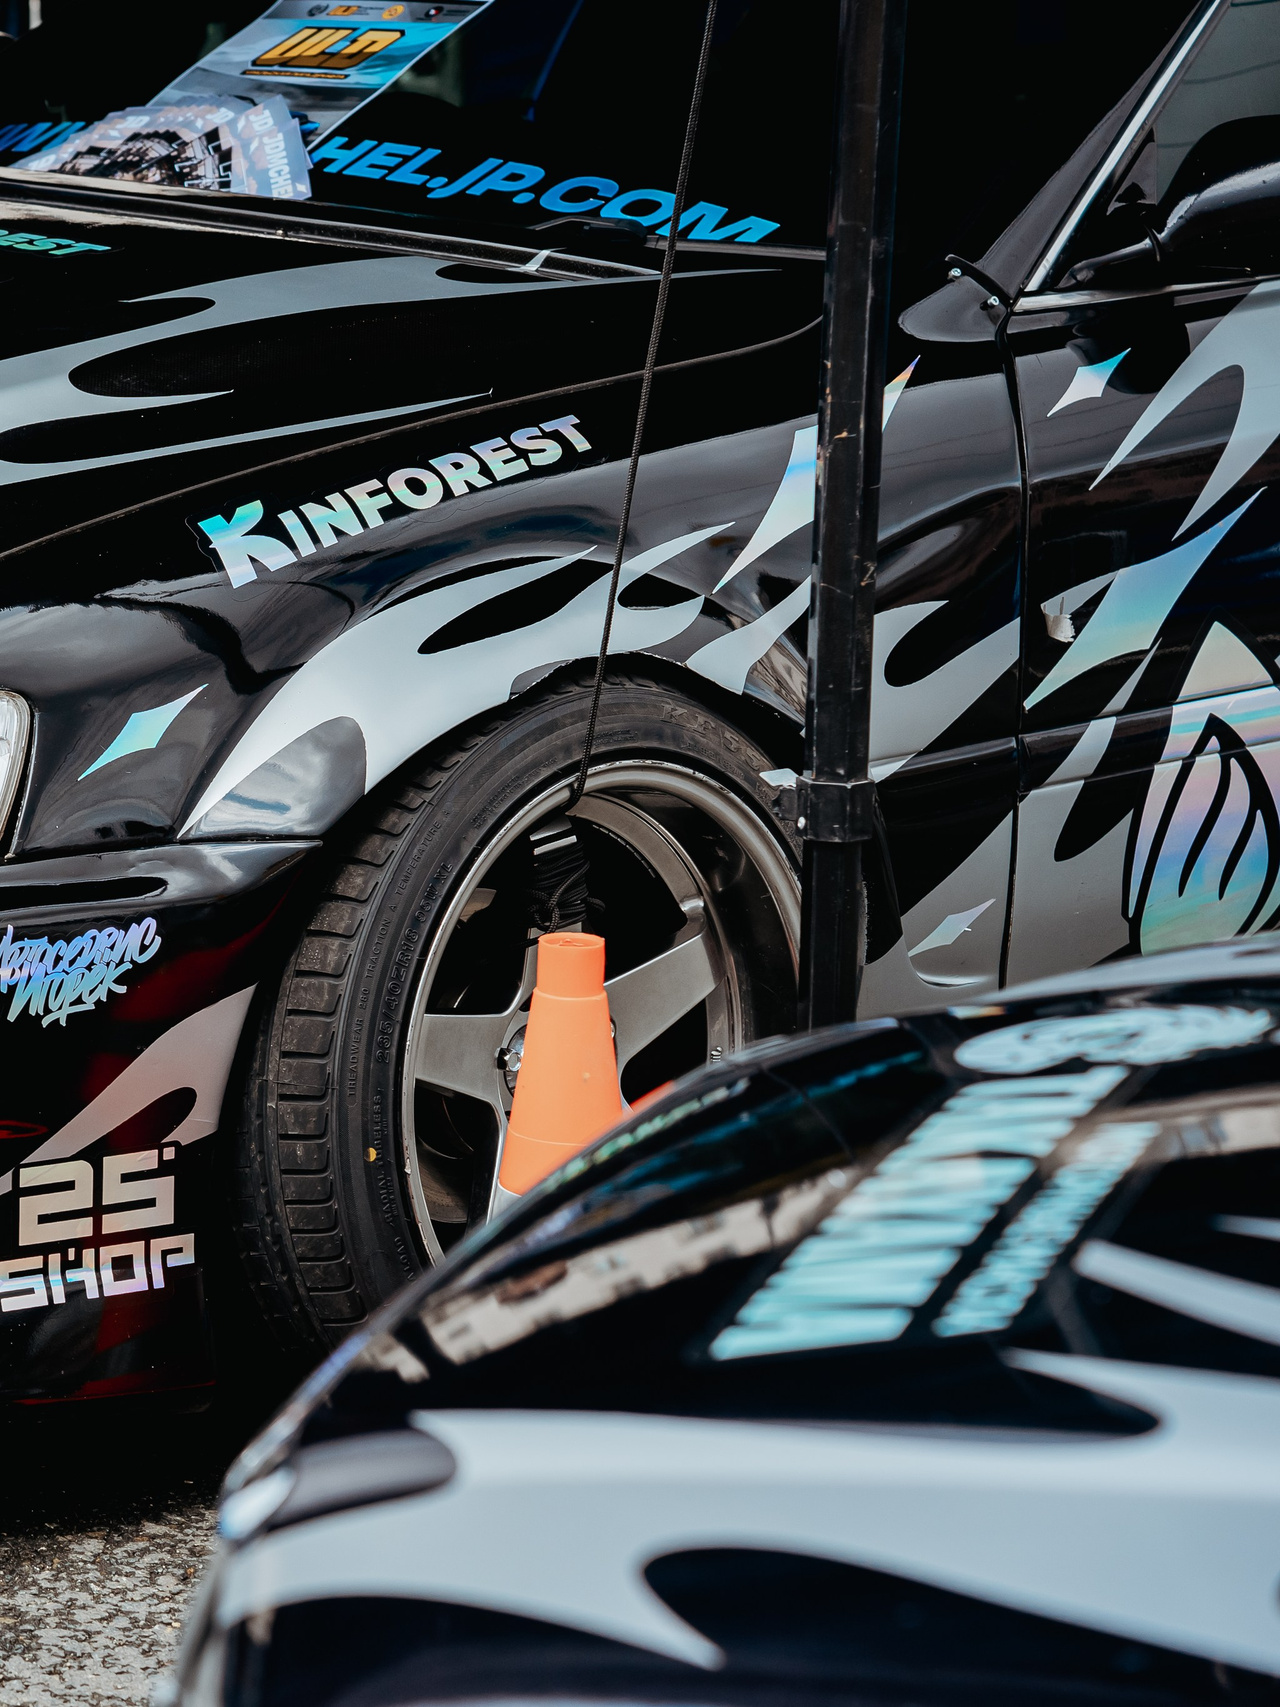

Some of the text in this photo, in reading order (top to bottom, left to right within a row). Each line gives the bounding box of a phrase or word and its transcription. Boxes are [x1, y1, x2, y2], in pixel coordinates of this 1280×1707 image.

[198, 414, 593, 589] KINFOREST
[347, 1018, 363, 1097] TREADWEAR
[365, 919, 391, 979] TRACTION
[389, 904, 397, 913] A
[394, 821, 442, 897] TEMPERATURE
[376, 927, 419, 1064] 235/40ZR18
